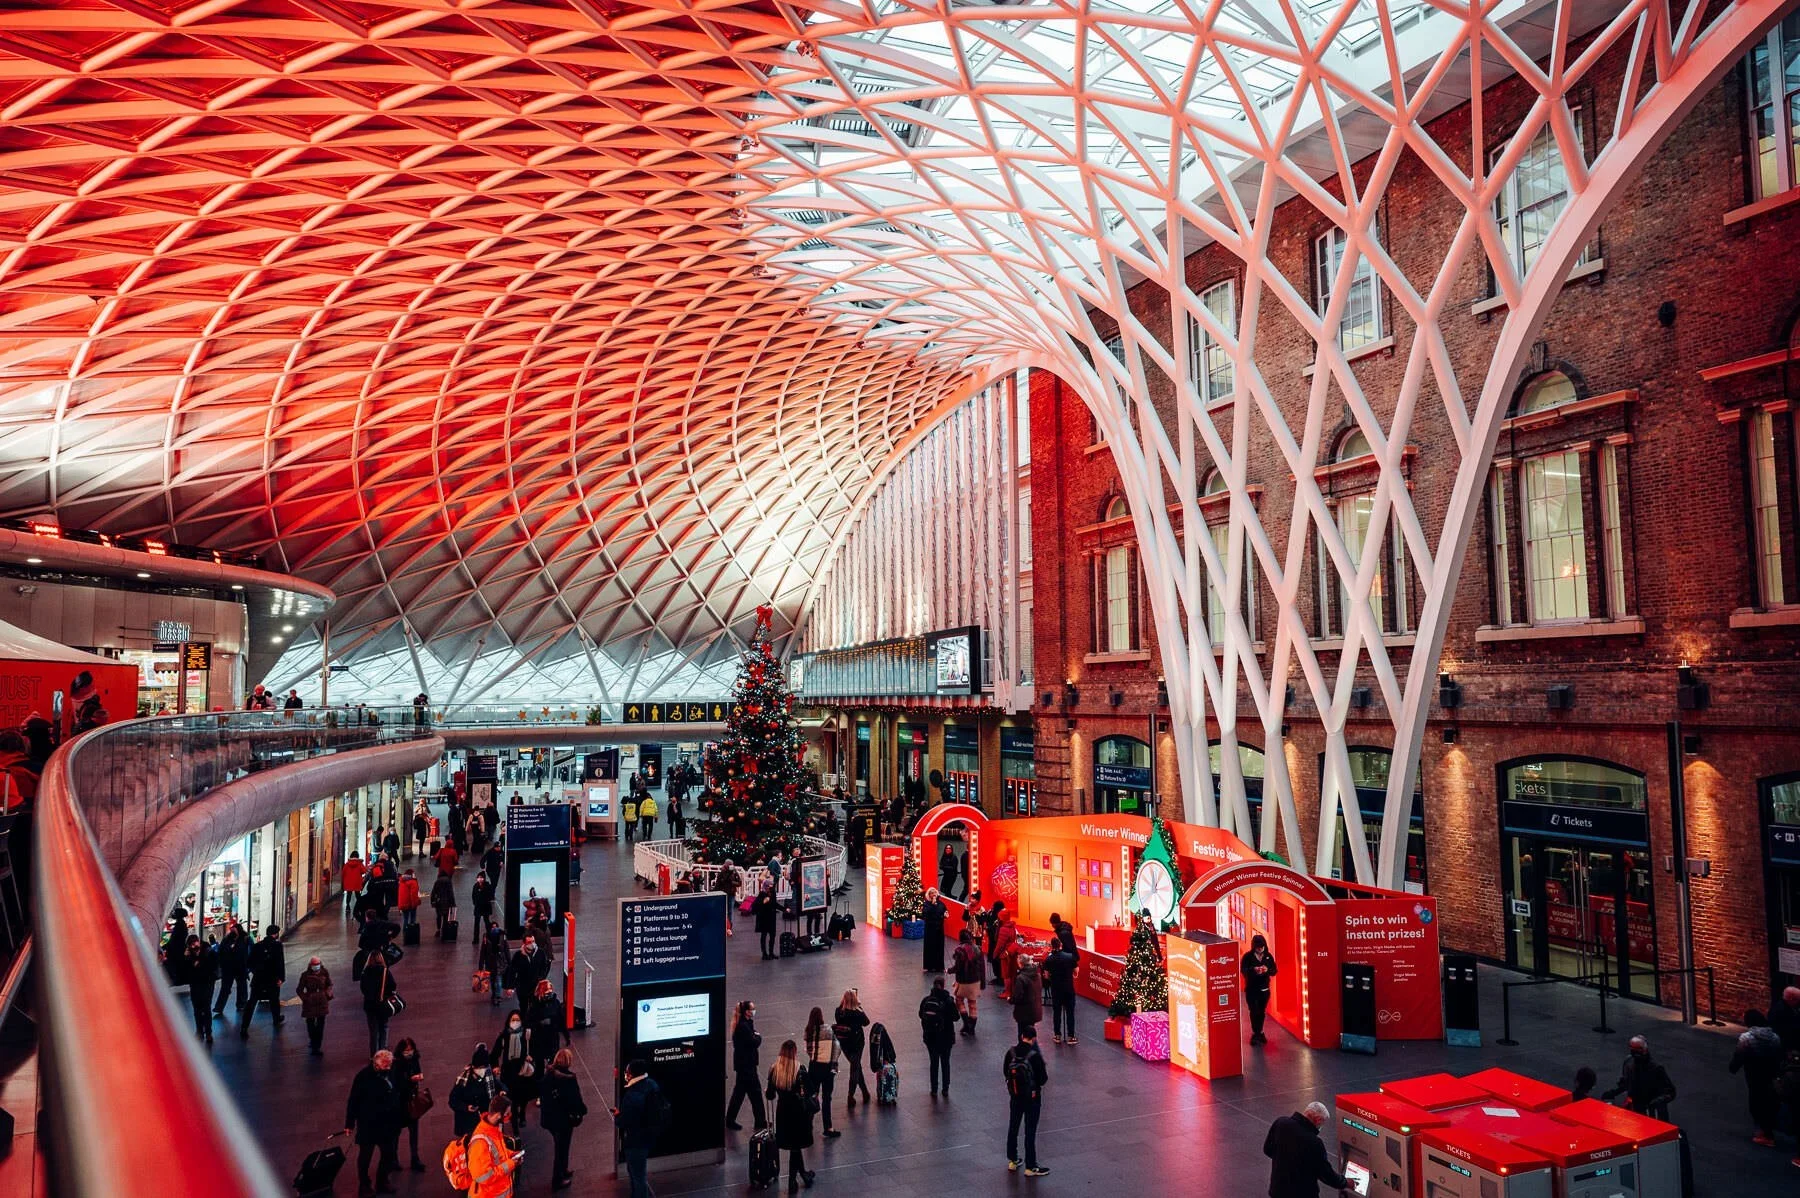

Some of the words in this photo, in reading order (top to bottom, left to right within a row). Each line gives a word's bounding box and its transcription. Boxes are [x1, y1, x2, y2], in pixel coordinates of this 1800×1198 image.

[1514, 782, 1546, 794] ckets
[1563, 816, 1592, 828] Tickets
[1080, 824, 1118, 838] Winner
[1194, 841, 1225, 858] Festive
[1214, 878, 1236, 892] Winner
[1236, 872, 1258, 880] Winner
[1260, 872, 1281, 880] Festive
[1282, 875, 1304, 889] Spinner
[644, 904, 678, 912] Underground
[1345, 915, 1370, 927] Spin
[1373, 916, 1384, 924] to
[1387, 914, 1407, 924] win
[1346, 930, 1385, 939] instant
[1389, 928, 1424, 940] prizes!
[1357, 1108, 1378, 1121] TICKETS
[1446, 1144, 1471, 1159] TICKETS
[1590, 1150, 1611, 1159] TICKETS
